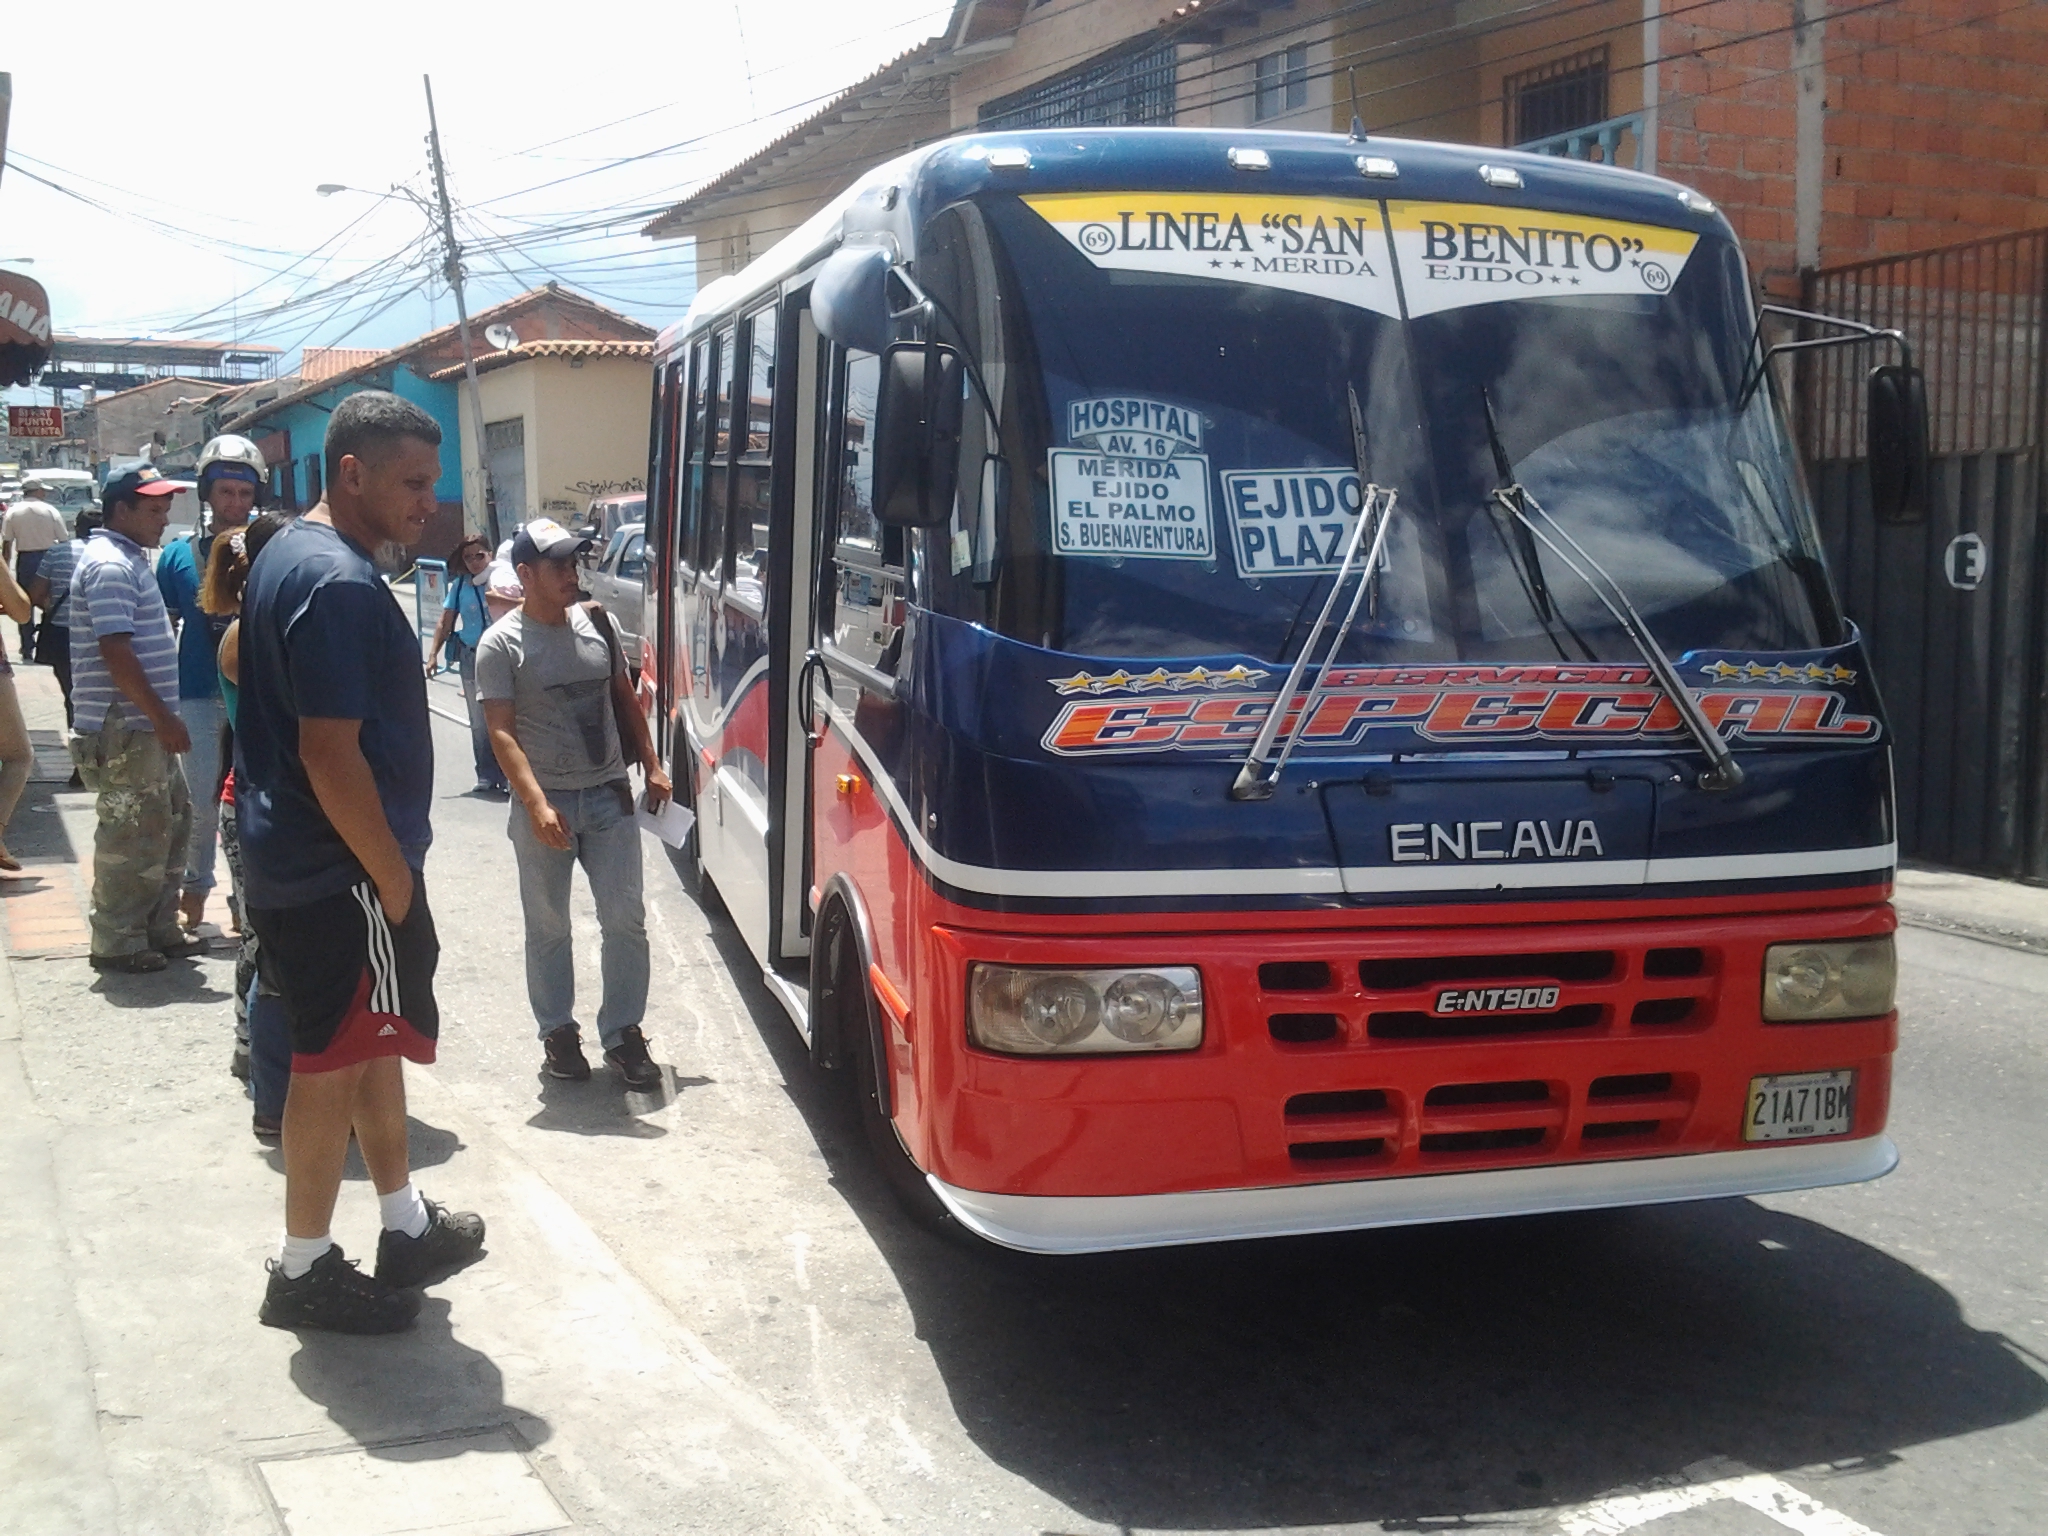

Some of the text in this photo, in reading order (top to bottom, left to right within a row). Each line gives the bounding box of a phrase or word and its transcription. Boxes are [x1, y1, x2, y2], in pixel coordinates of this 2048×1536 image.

[1085, 230, 1109, 248] 69
[1116, 211, 1254, 252] LINEA
[1250, 257, 1544, 285] MERIDA EJIDO
[1645, 269, 1666, 285] 69
[11, 426, 61, 436] DE VENTA
[18, 417, 54, 427] PUNTO
[1073, 400, 1198, 442] HOSPITAL
[1107, 436, 1166, 456] AV. 16
[1077, 459, 1181, 480] MERIDA
[1092, 481, 1170, 500] EJIDO
[1230, 475, 1362, 520] EJIDO
[1067, 501, 1196, 523] EL PALMO
[1060, 522, 1207, 551] S. BUENAVENTURA
[1953, 541, 1979, 584] E
[1318, 666, 1656, 688] SERVICIO
[1047, 689, 1879, 754] ESPECIAL
[1753, 1085, 1851, 1126] 21A71BM
